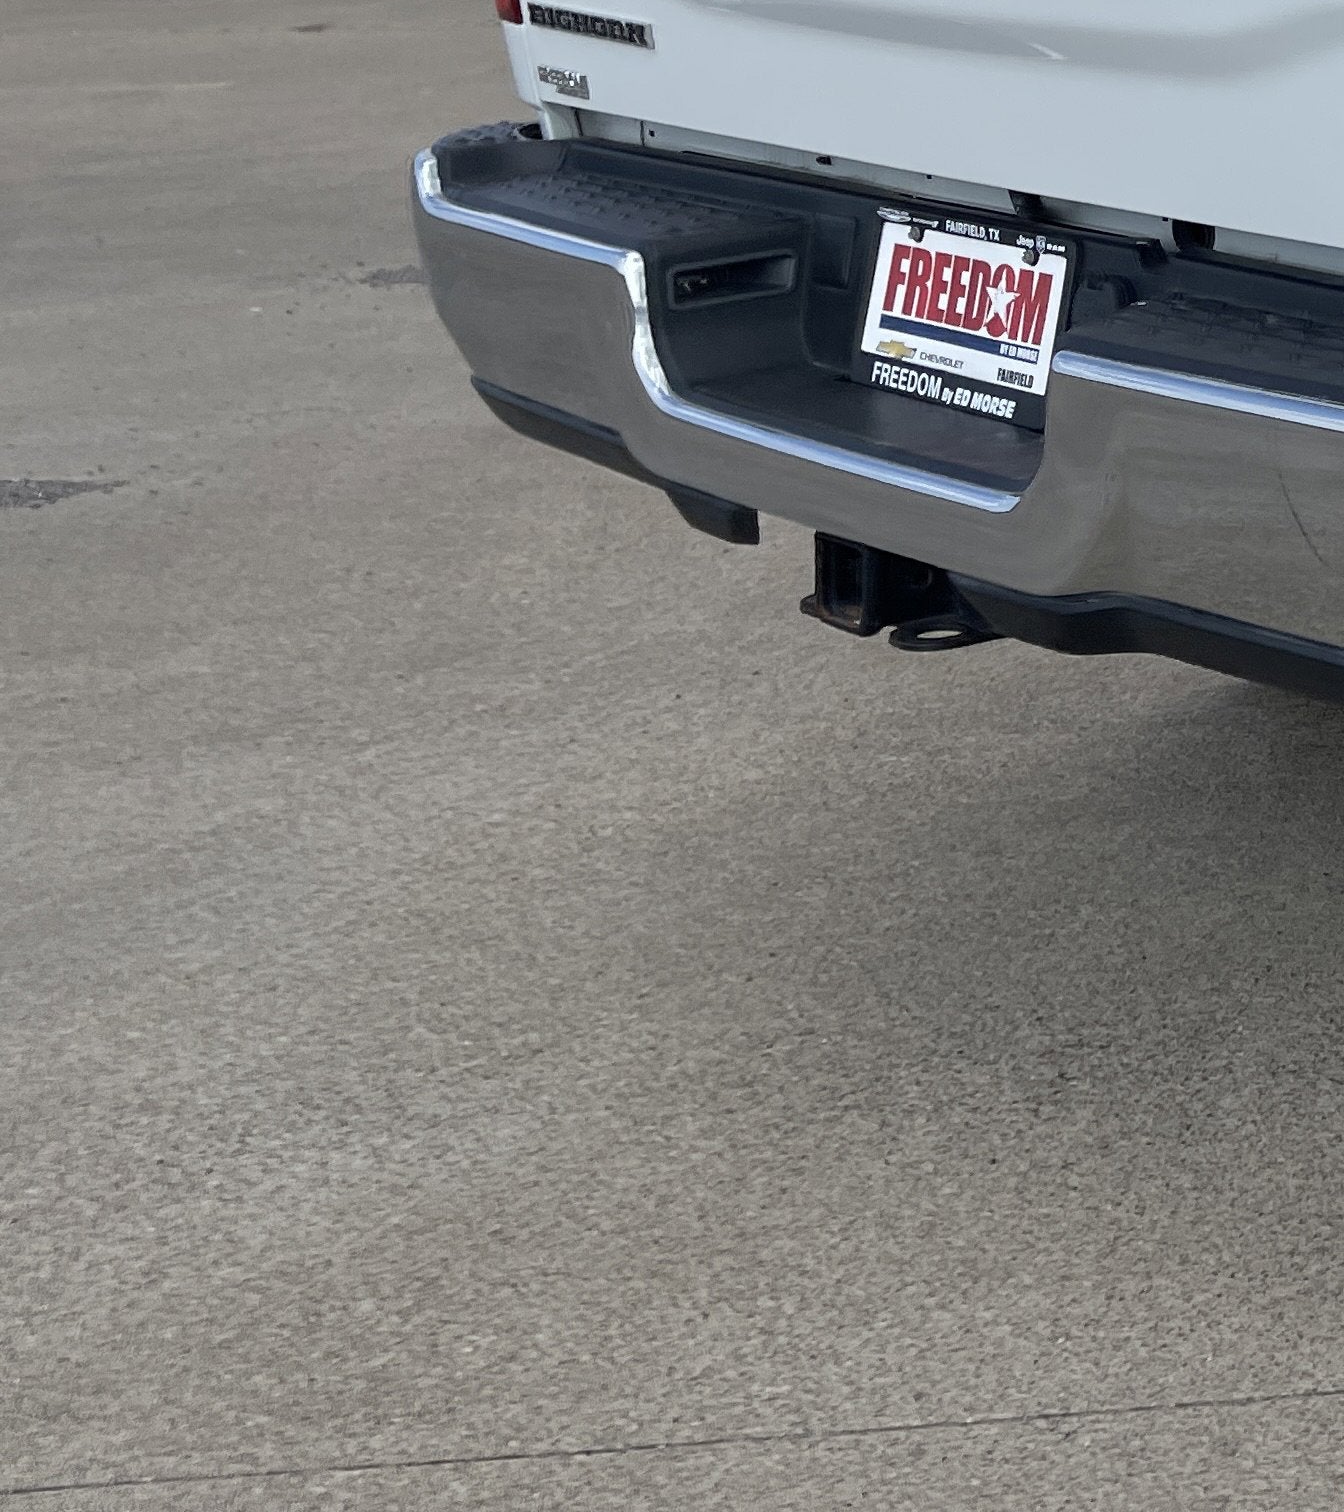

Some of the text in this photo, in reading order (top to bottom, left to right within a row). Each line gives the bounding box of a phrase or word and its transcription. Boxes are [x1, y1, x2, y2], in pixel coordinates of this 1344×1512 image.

[945, 219, 987, 241] FAIRFIELD,
[988, 228, 1000, 242] TX
[882, 243, 1054, 346] FREEDOM
[919, 351, 965, 369] CHEVROLET
[996, 367, 1034, 389] FAIRFIELD
[871, 361, 942, 400] FREEDOM
[953, 387, 971, 407] ED
[970, 392, 1017, 419] MORSE
